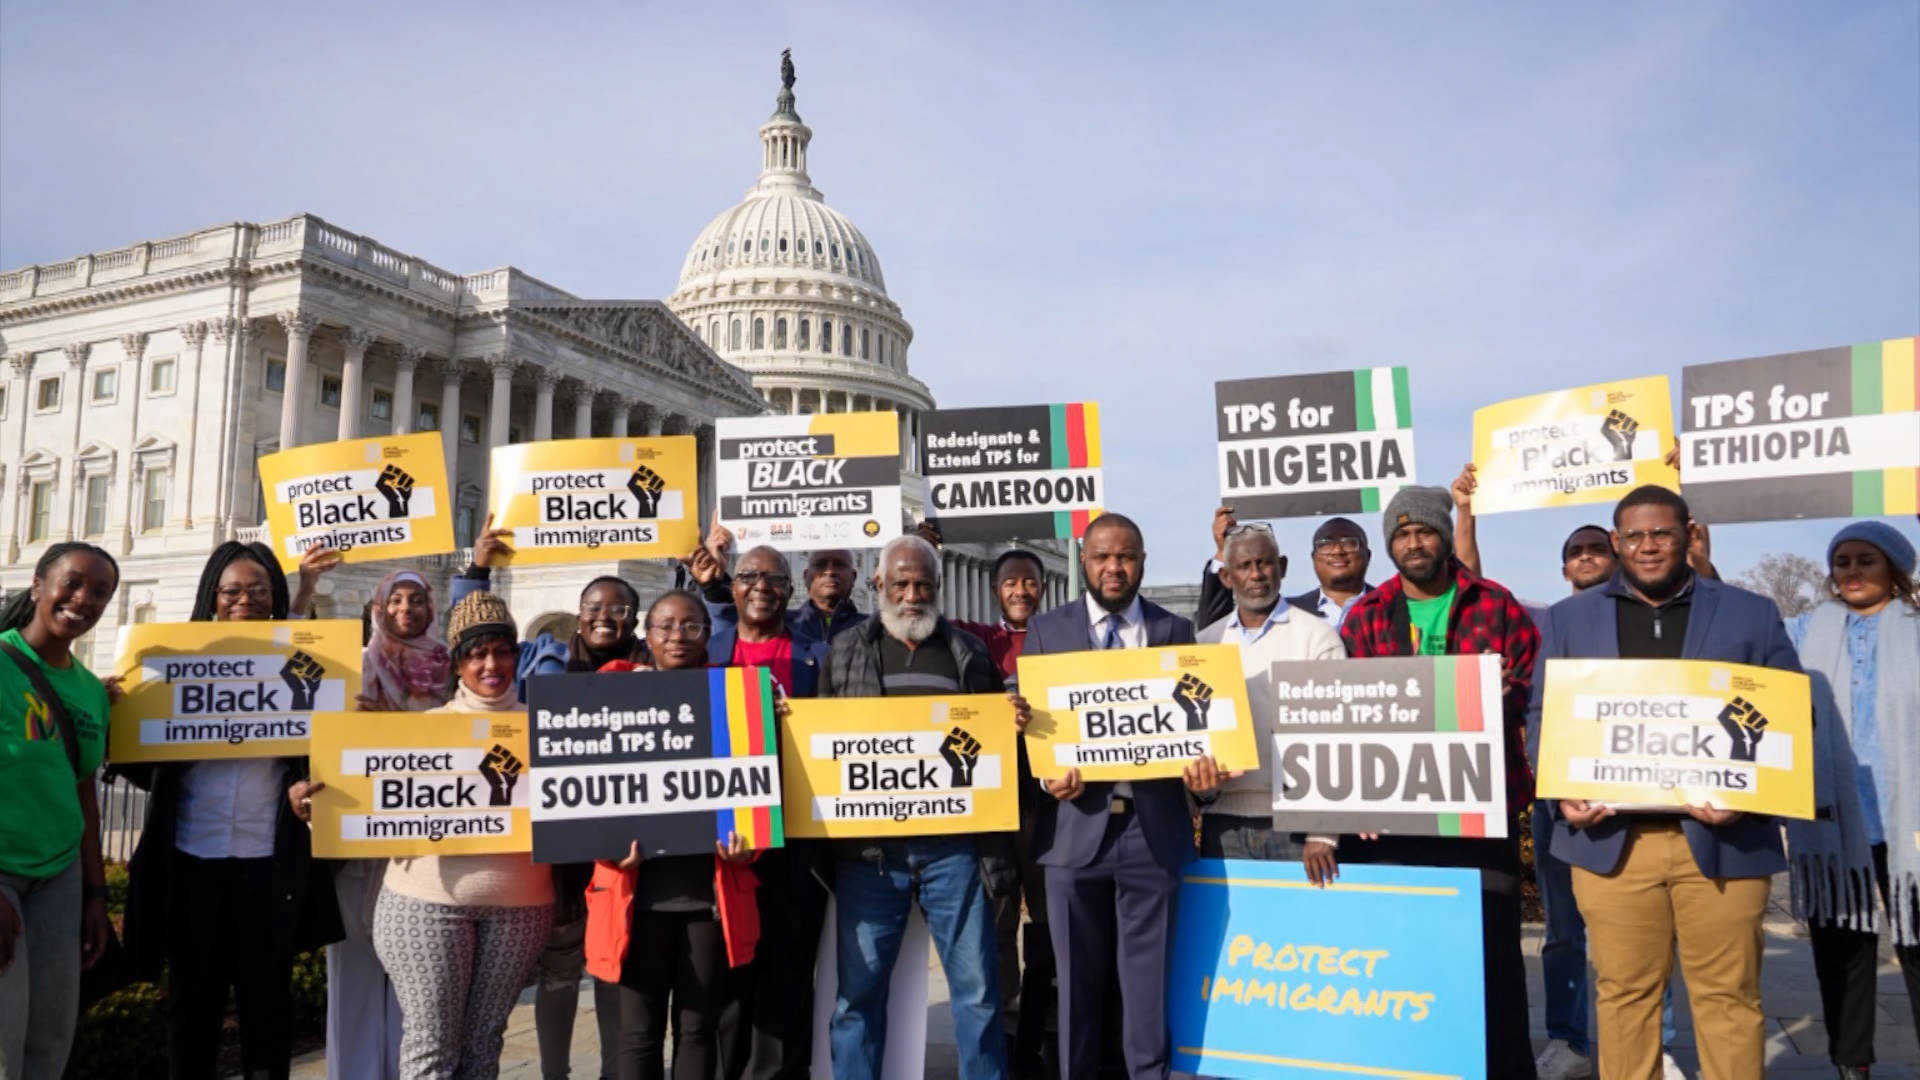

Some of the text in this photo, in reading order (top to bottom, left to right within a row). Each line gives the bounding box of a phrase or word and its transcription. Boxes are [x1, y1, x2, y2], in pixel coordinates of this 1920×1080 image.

[1223, 397, 1334, 434] TPS for
[1691, 384, 1829, 428] TPS for
[739, 438, 817, 458] protect
[927, 429, 1040, 449] Redesignate &
[1693, 426, 1850, 467] ETHIOPIA
[928, 448, 1040, 468] Extend TPS for
[1226, 439, 1406, 488] NIGERIA
[532, 472, 604, 495] protect
[752, 459, 846, 487] BLACK
[288, 474, 352, 502] protect
[931, 476, 1095, 509] CAMEROON
[300, 495, 376, 528] Black
[547, 494, 626, 521] Black
[741, 493, 866, 517] immigrants
[535, 526, 652, 548] immigrants
[166, 659, 255, 683] protect
[181, 682, 279, 714] Black
[1069, 683, 1149, 711] protect
[1278, 678, 1421, 703] Redesignate &
[537, 706, 670, 731] Redesignate
[678, 703, 695, 724] &
[1086, 705, 1174, 739] Black
[1279, 702, 1420, 724] Extend TPS for
[1596, 699, 1688, 721] protect
[165, 718, 306, 744] immigrants
[538, 729, 694, 757] Extend TPS for
[1612, 724, 1715, 758] Black
[832, 736, 914, 761] protect
[1076, 740, 1204, 766] immigrants
[365, 753, 453, 777] protect
[848, 759, 938, 790] Black
[1282, 743, 1492, 802] SUDAN
[1593, 760, 1748, 790] immigrants
[381, 776, 477, 808] Black
[542, 766, 771, 809] SOUTH SUDAN
[836, 796, 966, 822] immigrants
[366, 814, 504, 841] immigrants
[1228, 934, 1389, 978] PROTECT
[1202, 976, 1435, 1021] IMMIGRANTS
